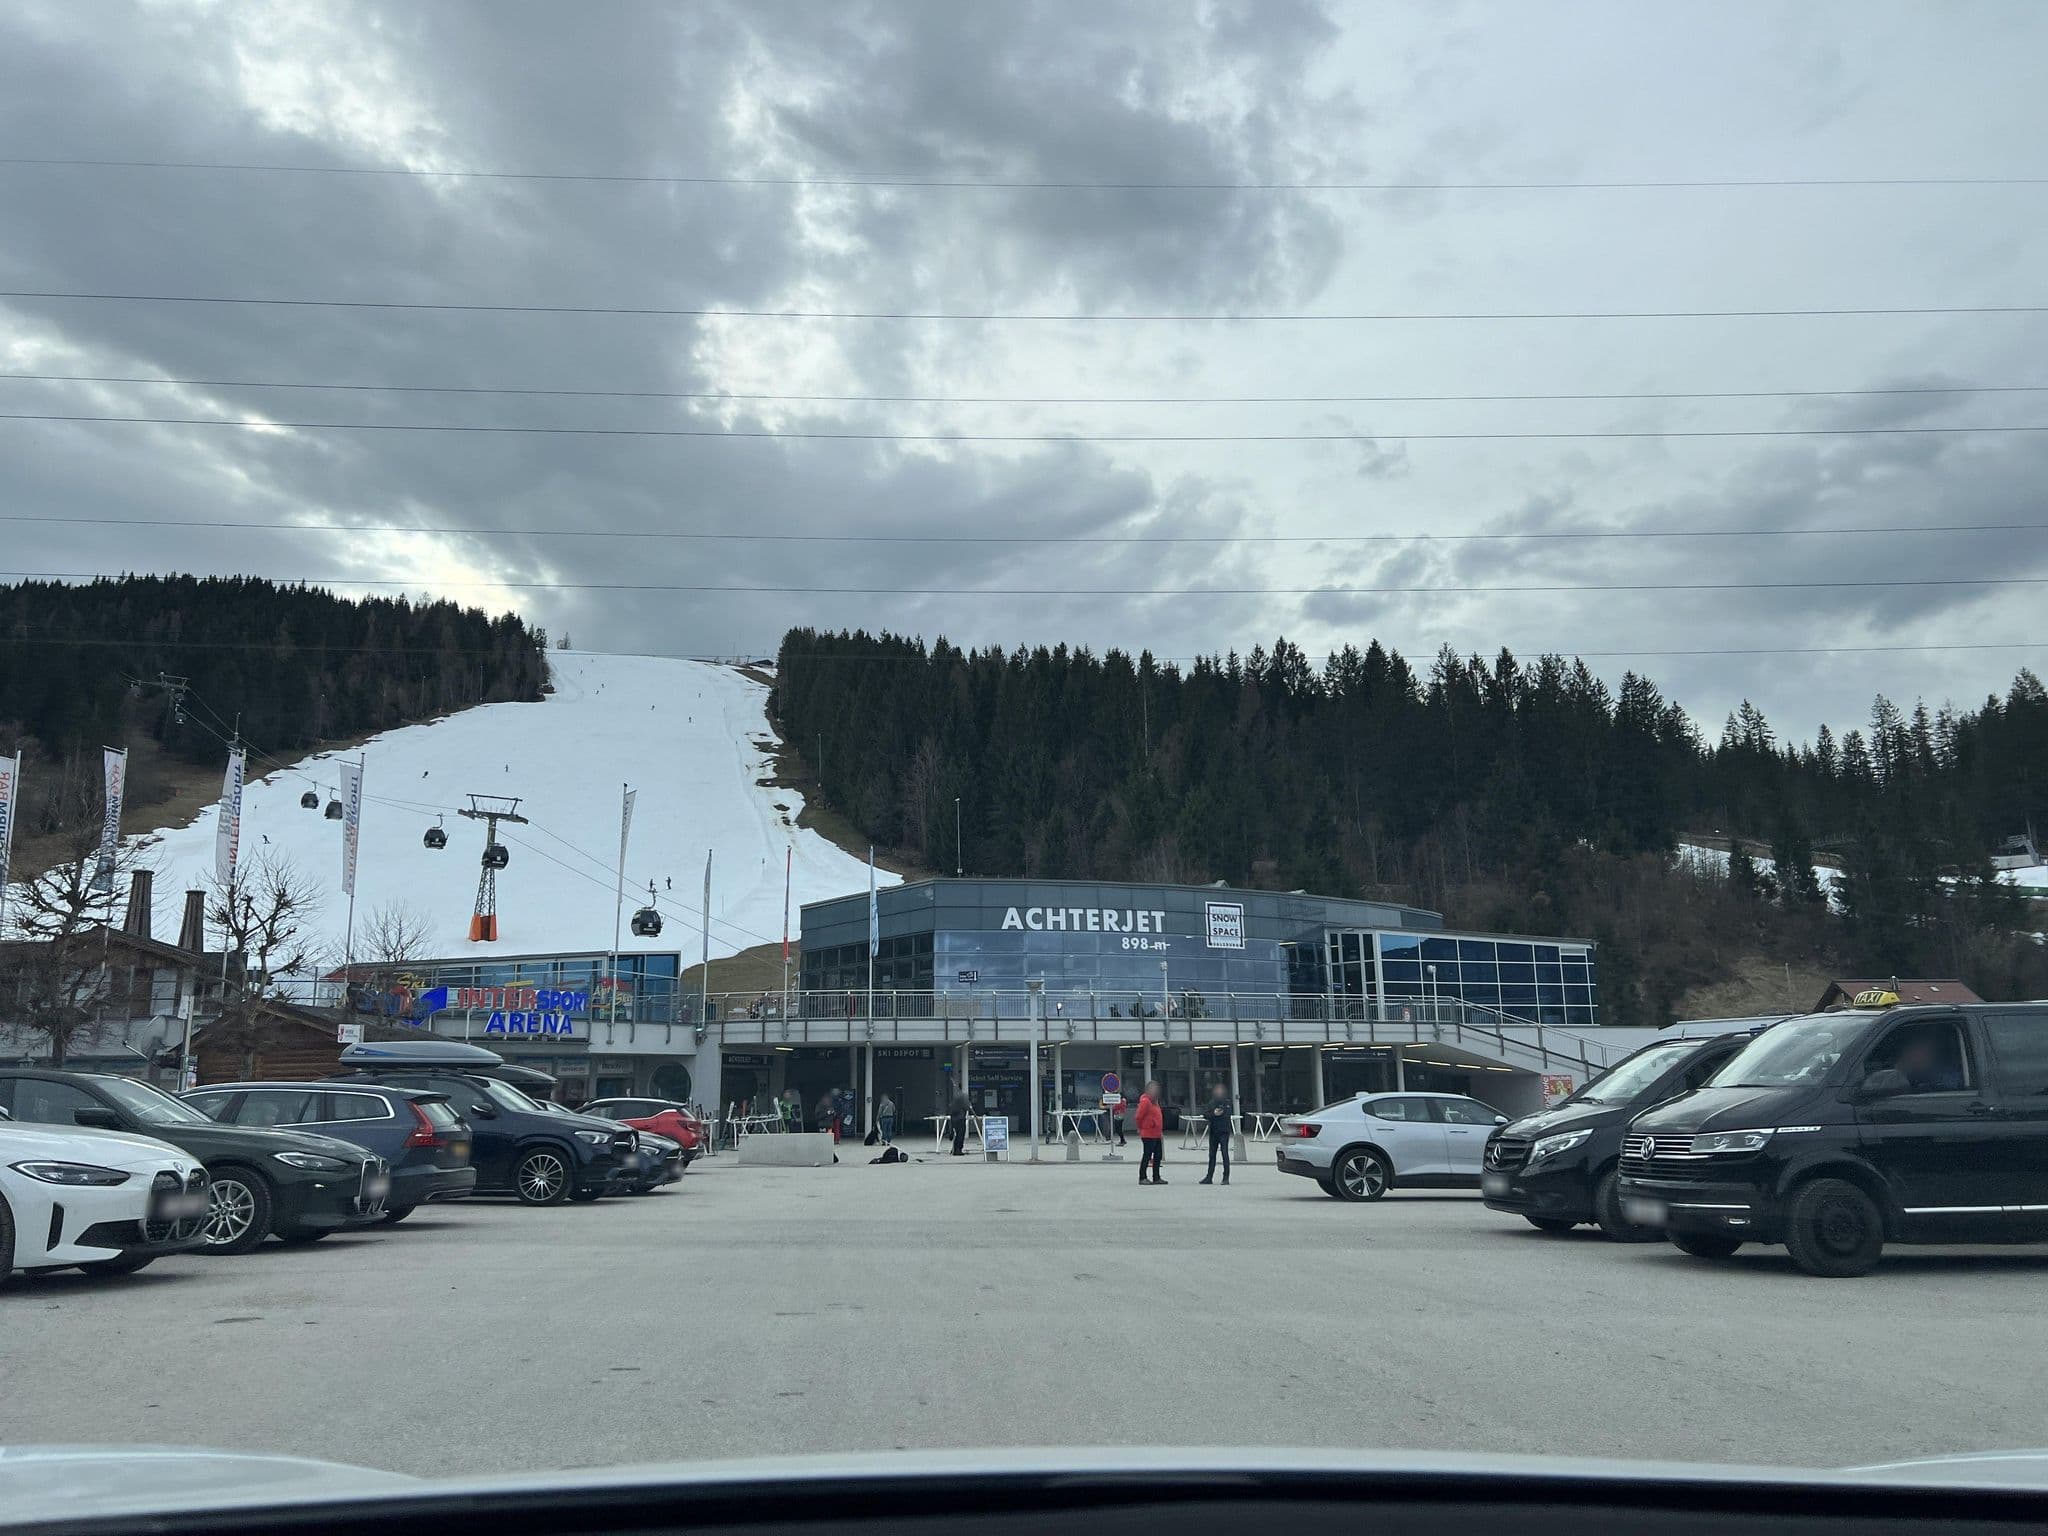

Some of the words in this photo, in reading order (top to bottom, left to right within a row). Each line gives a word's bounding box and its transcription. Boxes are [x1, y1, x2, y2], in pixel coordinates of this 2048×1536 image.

[1001, 907, 1165, 933] ACHTERJET
[1212, 914, 1238, 923] SNOW
[1213, 927, 1239, 936] SPACE
[1122, 937, 1149, 950] 898
[458, 986, 589, 1012] INTERSPORT
[1856, 991, 1882, 1004] TAXI
[484, 1012, 573, 1034] ARENA
[878, 1049, 891, 1057] SKI
[893, 1049, 920, 1057] DEPOT
